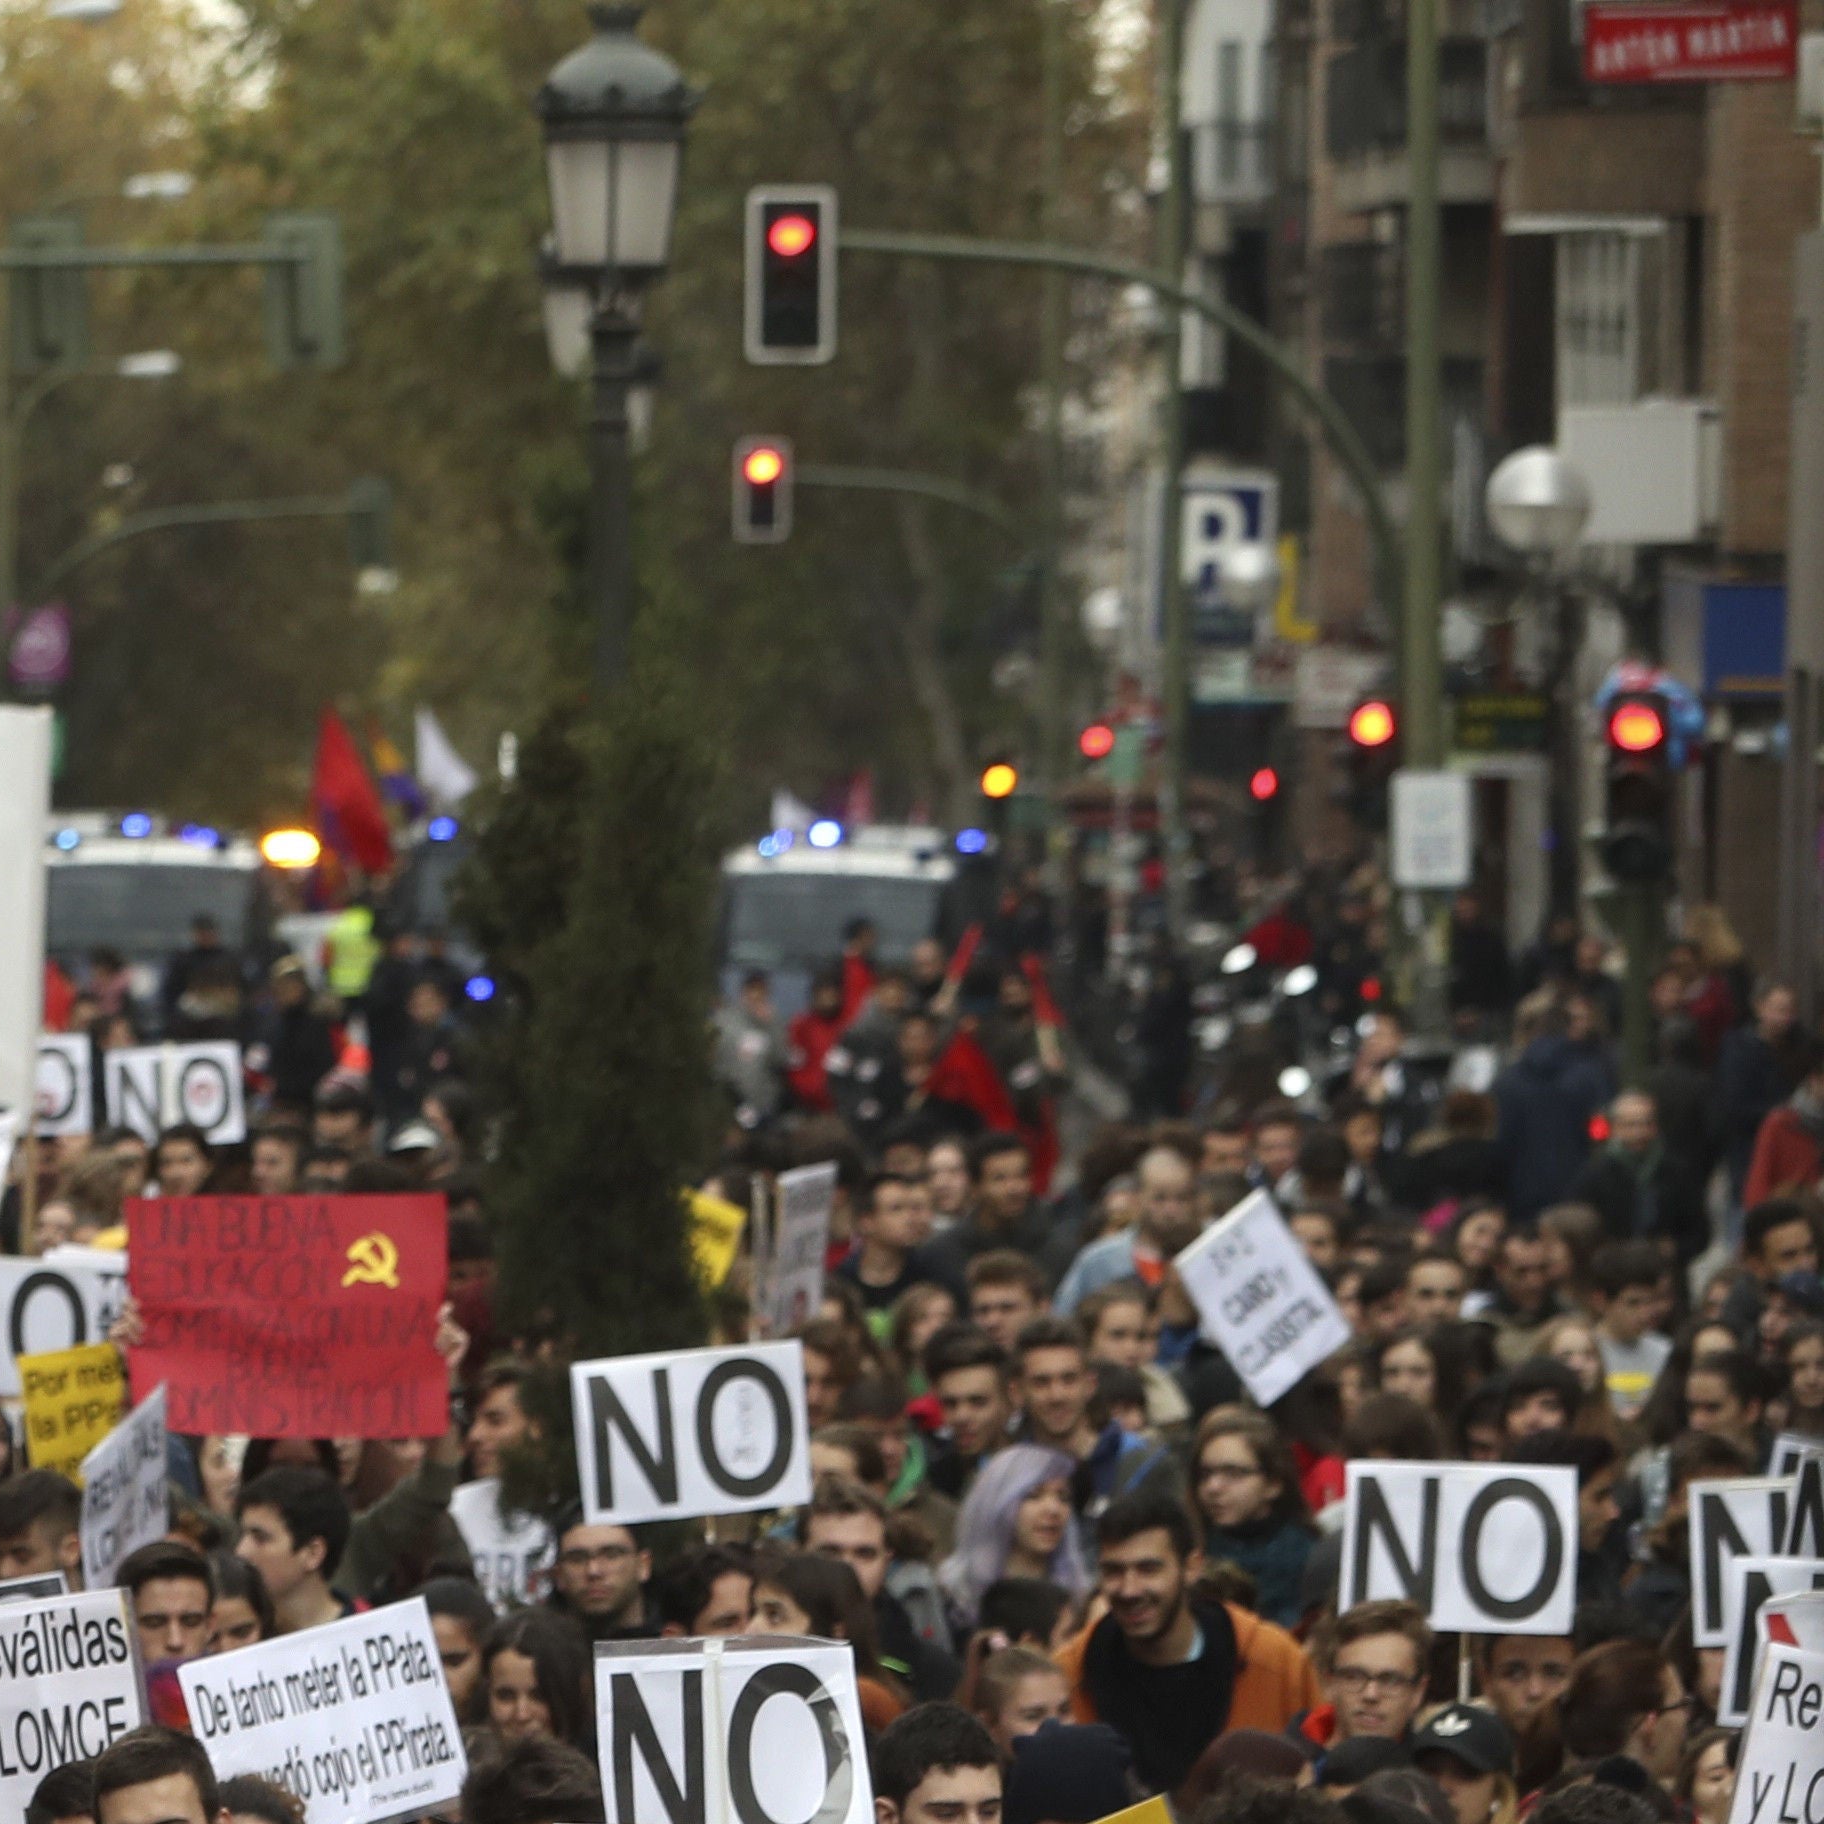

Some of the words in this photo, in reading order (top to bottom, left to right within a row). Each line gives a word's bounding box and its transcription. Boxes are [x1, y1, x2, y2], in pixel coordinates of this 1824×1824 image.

[588, 1358, 794, 1511] NO
[1353, 1475, 1564, 1621] NO
[193, 1684, 231, 1738] De
[228, 1669, 285, 1731] tanto
[283, 1654, 344, 1716] meter
[340, 1645, 368, 1700] la
[364, 1630, 440, 1694] PPata,
